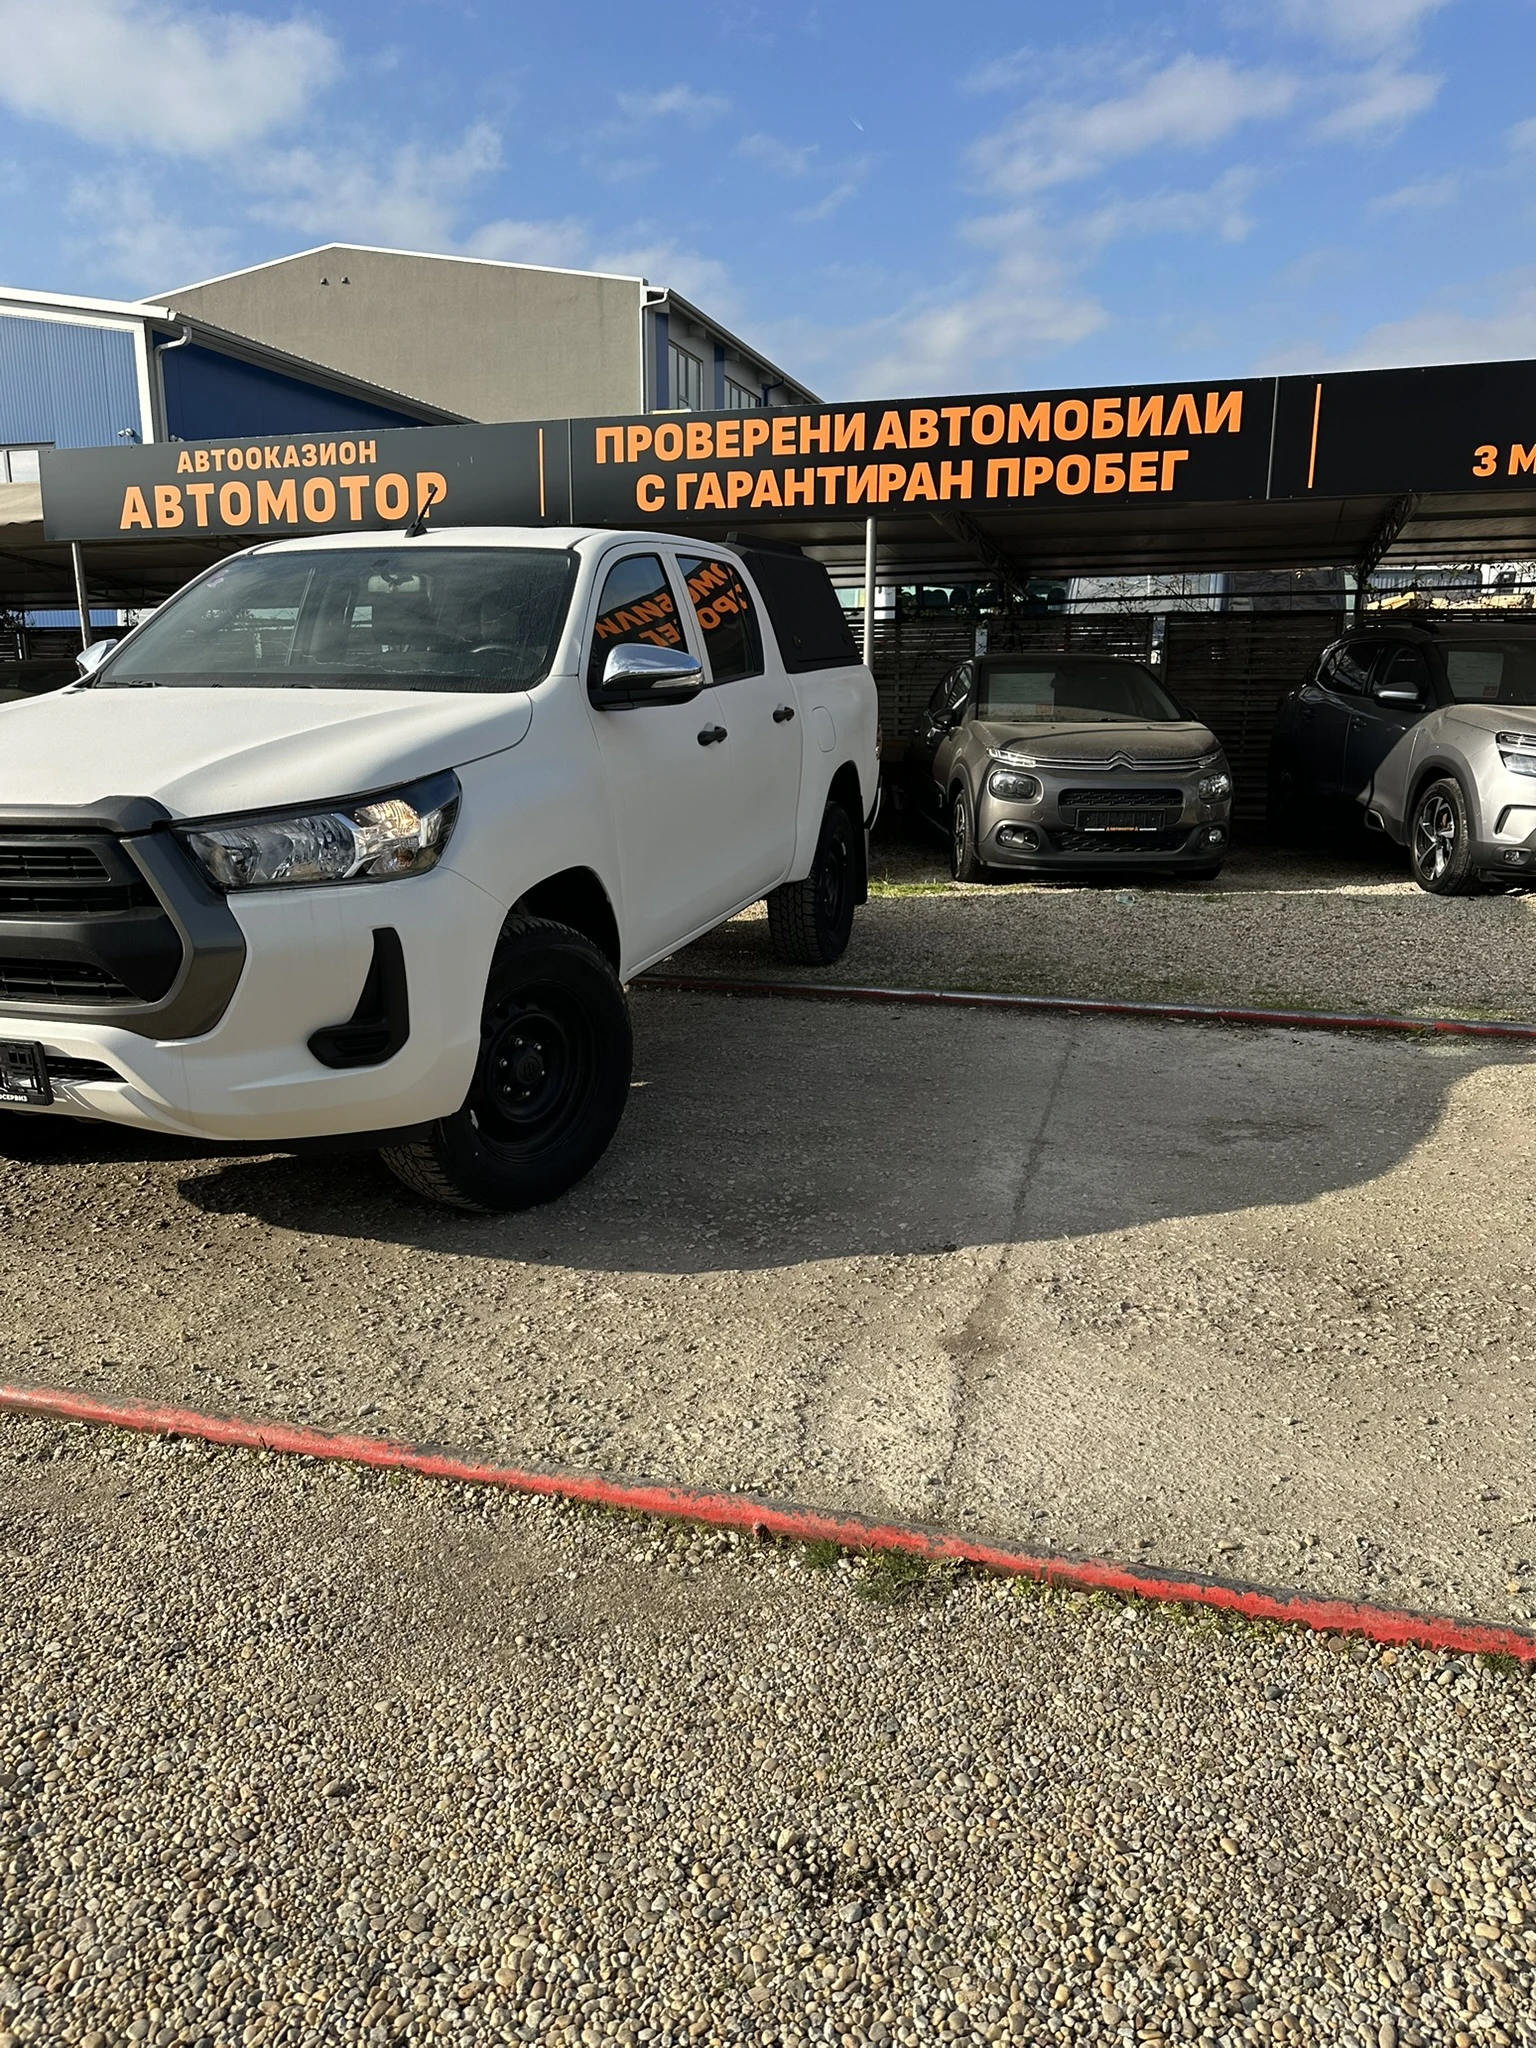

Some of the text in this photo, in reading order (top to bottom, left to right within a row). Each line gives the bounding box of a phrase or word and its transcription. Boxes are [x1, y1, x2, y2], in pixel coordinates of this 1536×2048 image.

[176, 439, 377, 474] АВТООКАЗИОН
[595, 390, 1243, 464] ПРОВЕРЕНИ АВТОМОБИЛИ
[636, 449, 1190, 512] С ГАРАНТИРАН ПРОБЕГ
[1472, 444, 1499, 477] 3
[119, 471, 448, 530] АВТОМОТОР
